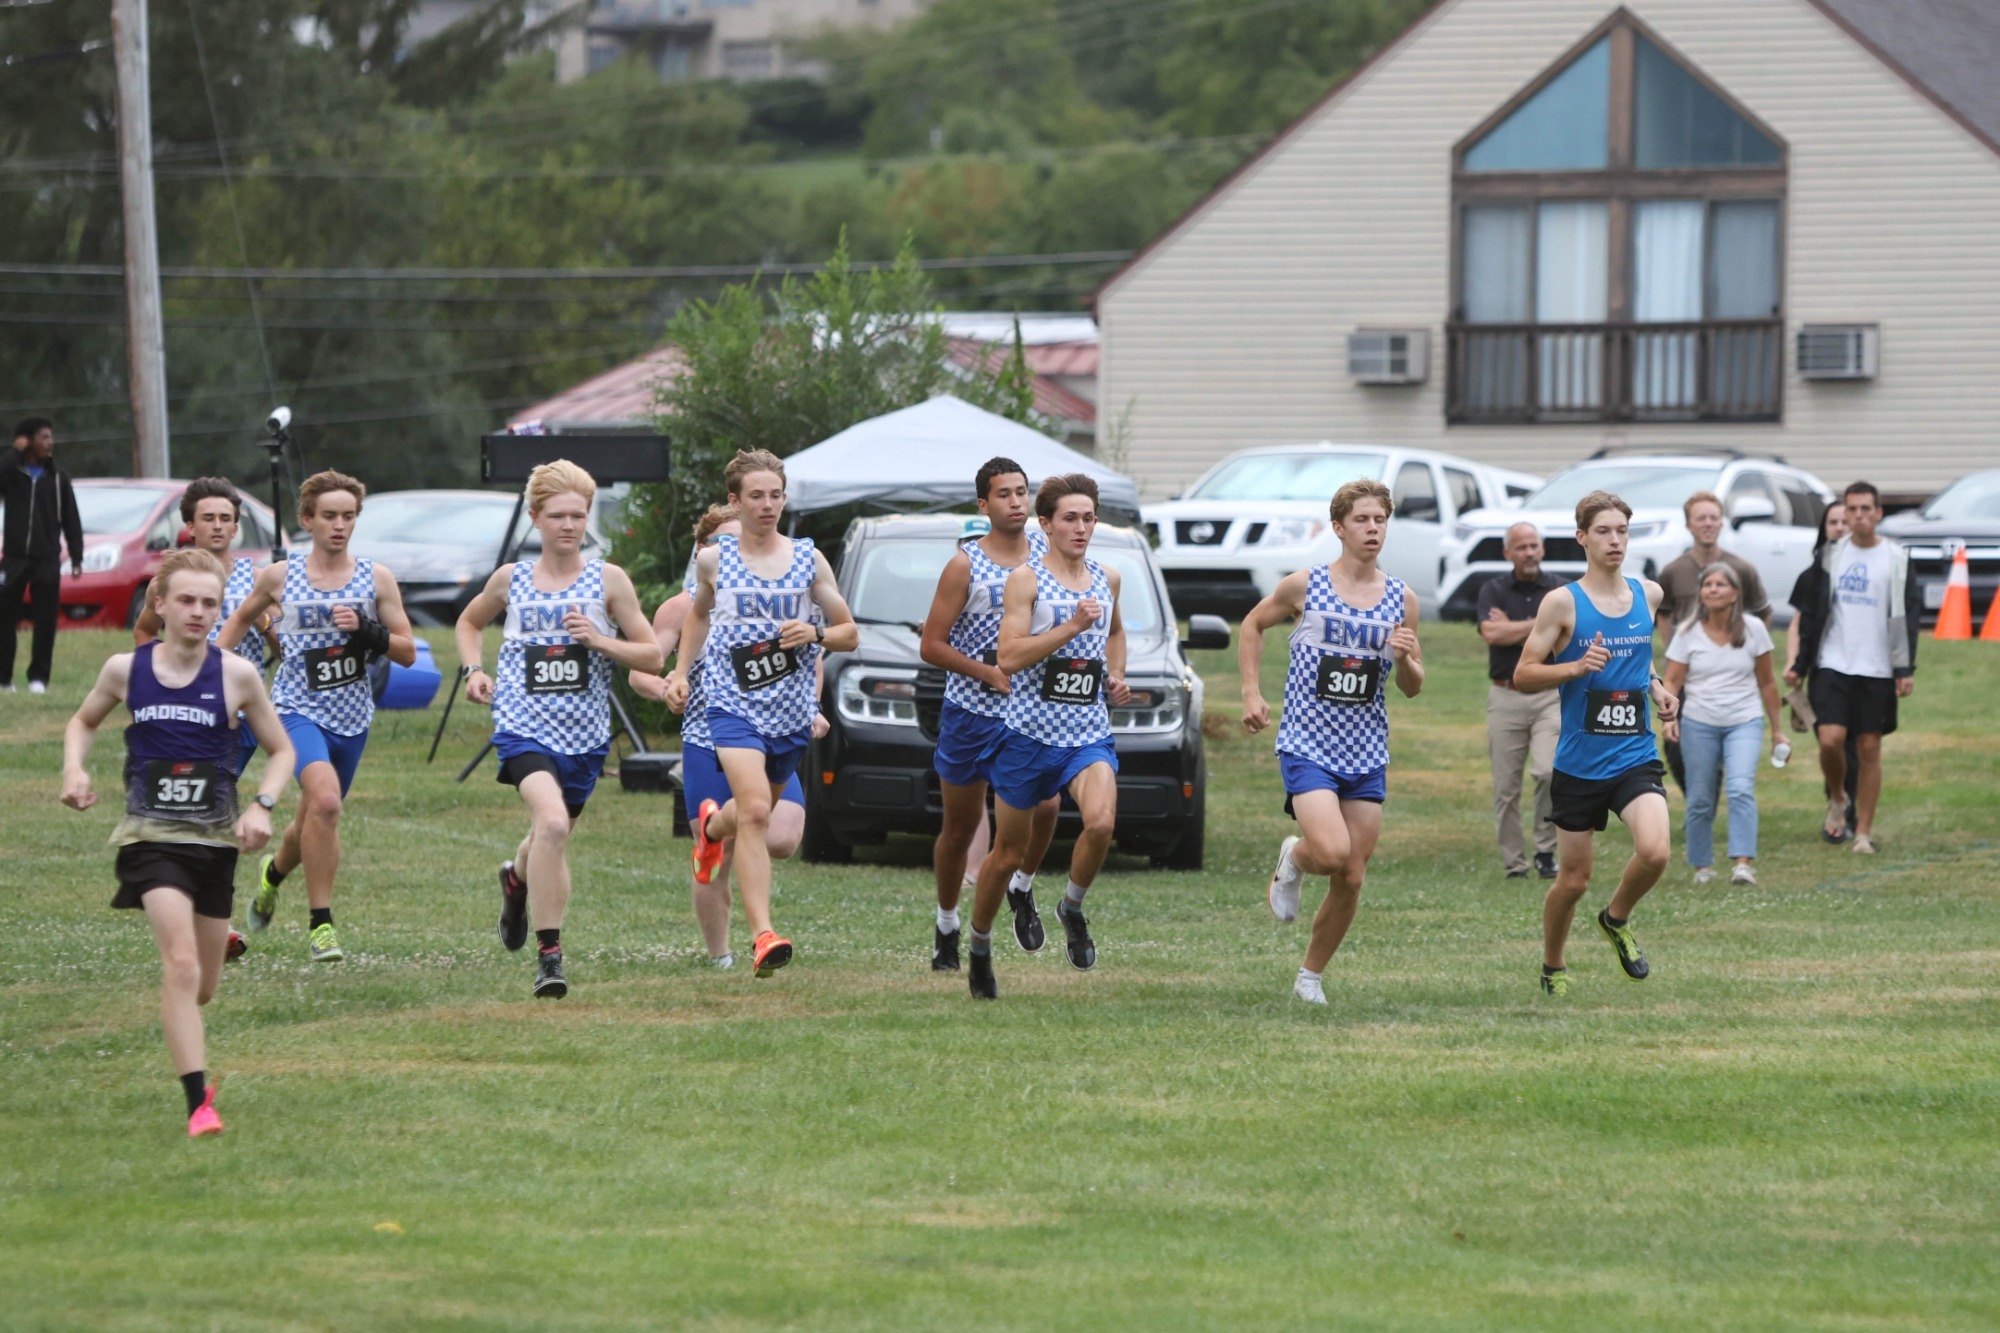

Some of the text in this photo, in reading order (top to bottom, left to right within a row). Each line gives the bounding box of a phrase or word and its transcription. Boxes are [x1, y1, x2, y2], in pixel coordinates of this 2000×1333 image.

[733, 592, 804, 619] EMU
[1050, 604, 1108, 630] EU
[1321, 616, 1392, 651] EMU
[1579, 638, 1613, 647] EASRN
[316, 656, 357, 682] 310
[534, 660, 579, 683] 309
[744, 652, 787, 681] 319
[1053, 672, 1094, 695] 320
[1328, 671, 1368, 694] 301
[134, 705, 216, 727] MADISON
[1597, 705, 1636, 726] 493
[157, 778, 207, 802] 357
